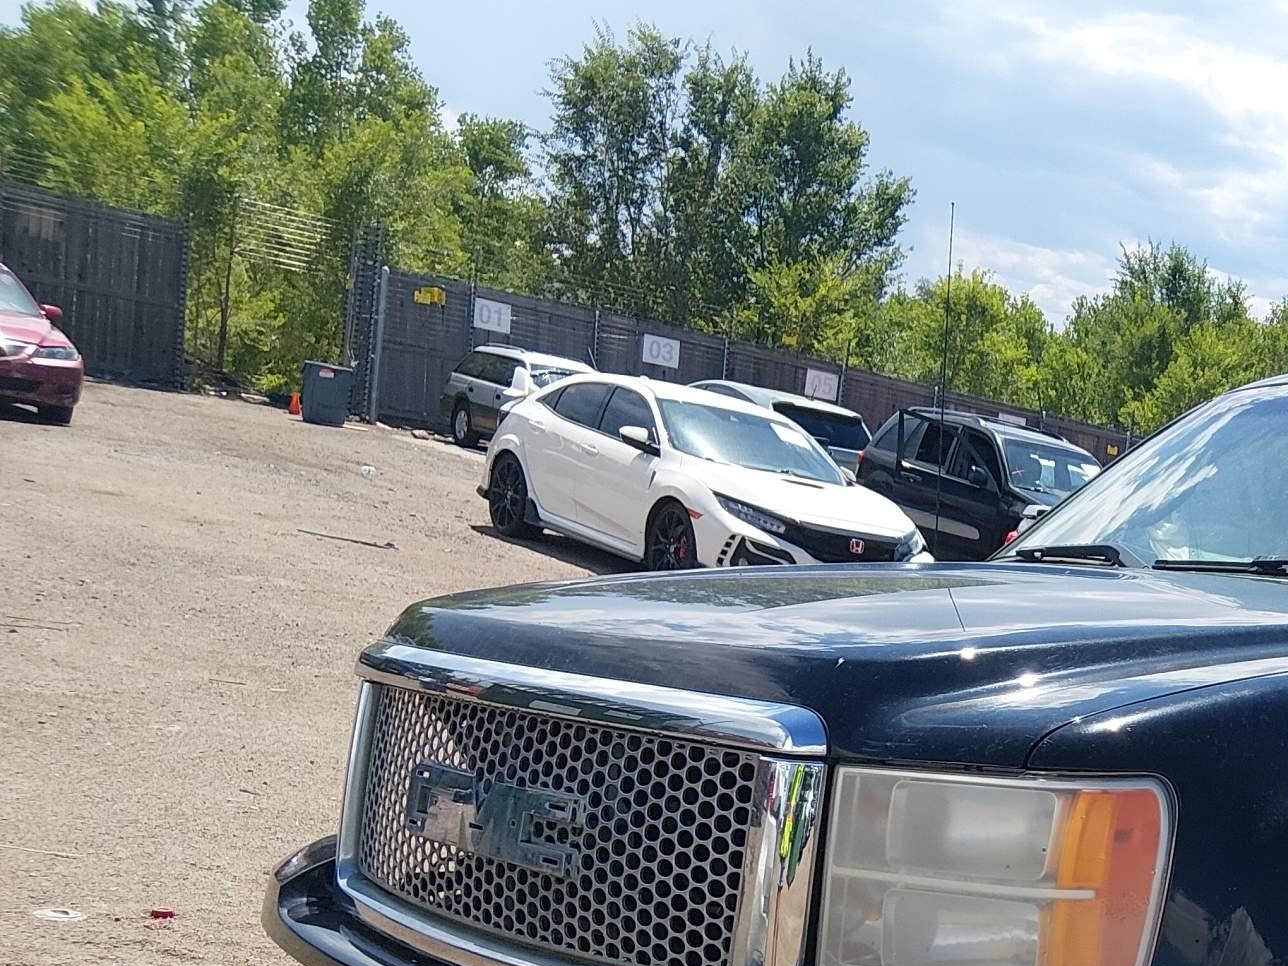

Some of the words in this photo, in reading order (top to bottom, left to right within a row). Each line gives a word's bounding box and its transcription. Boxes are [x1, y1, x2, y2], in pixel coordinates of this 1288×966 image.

[479, 304, 502, 327] 01
[649, 340, 674, 362] 03
[811, 374, 834, 395] 05
